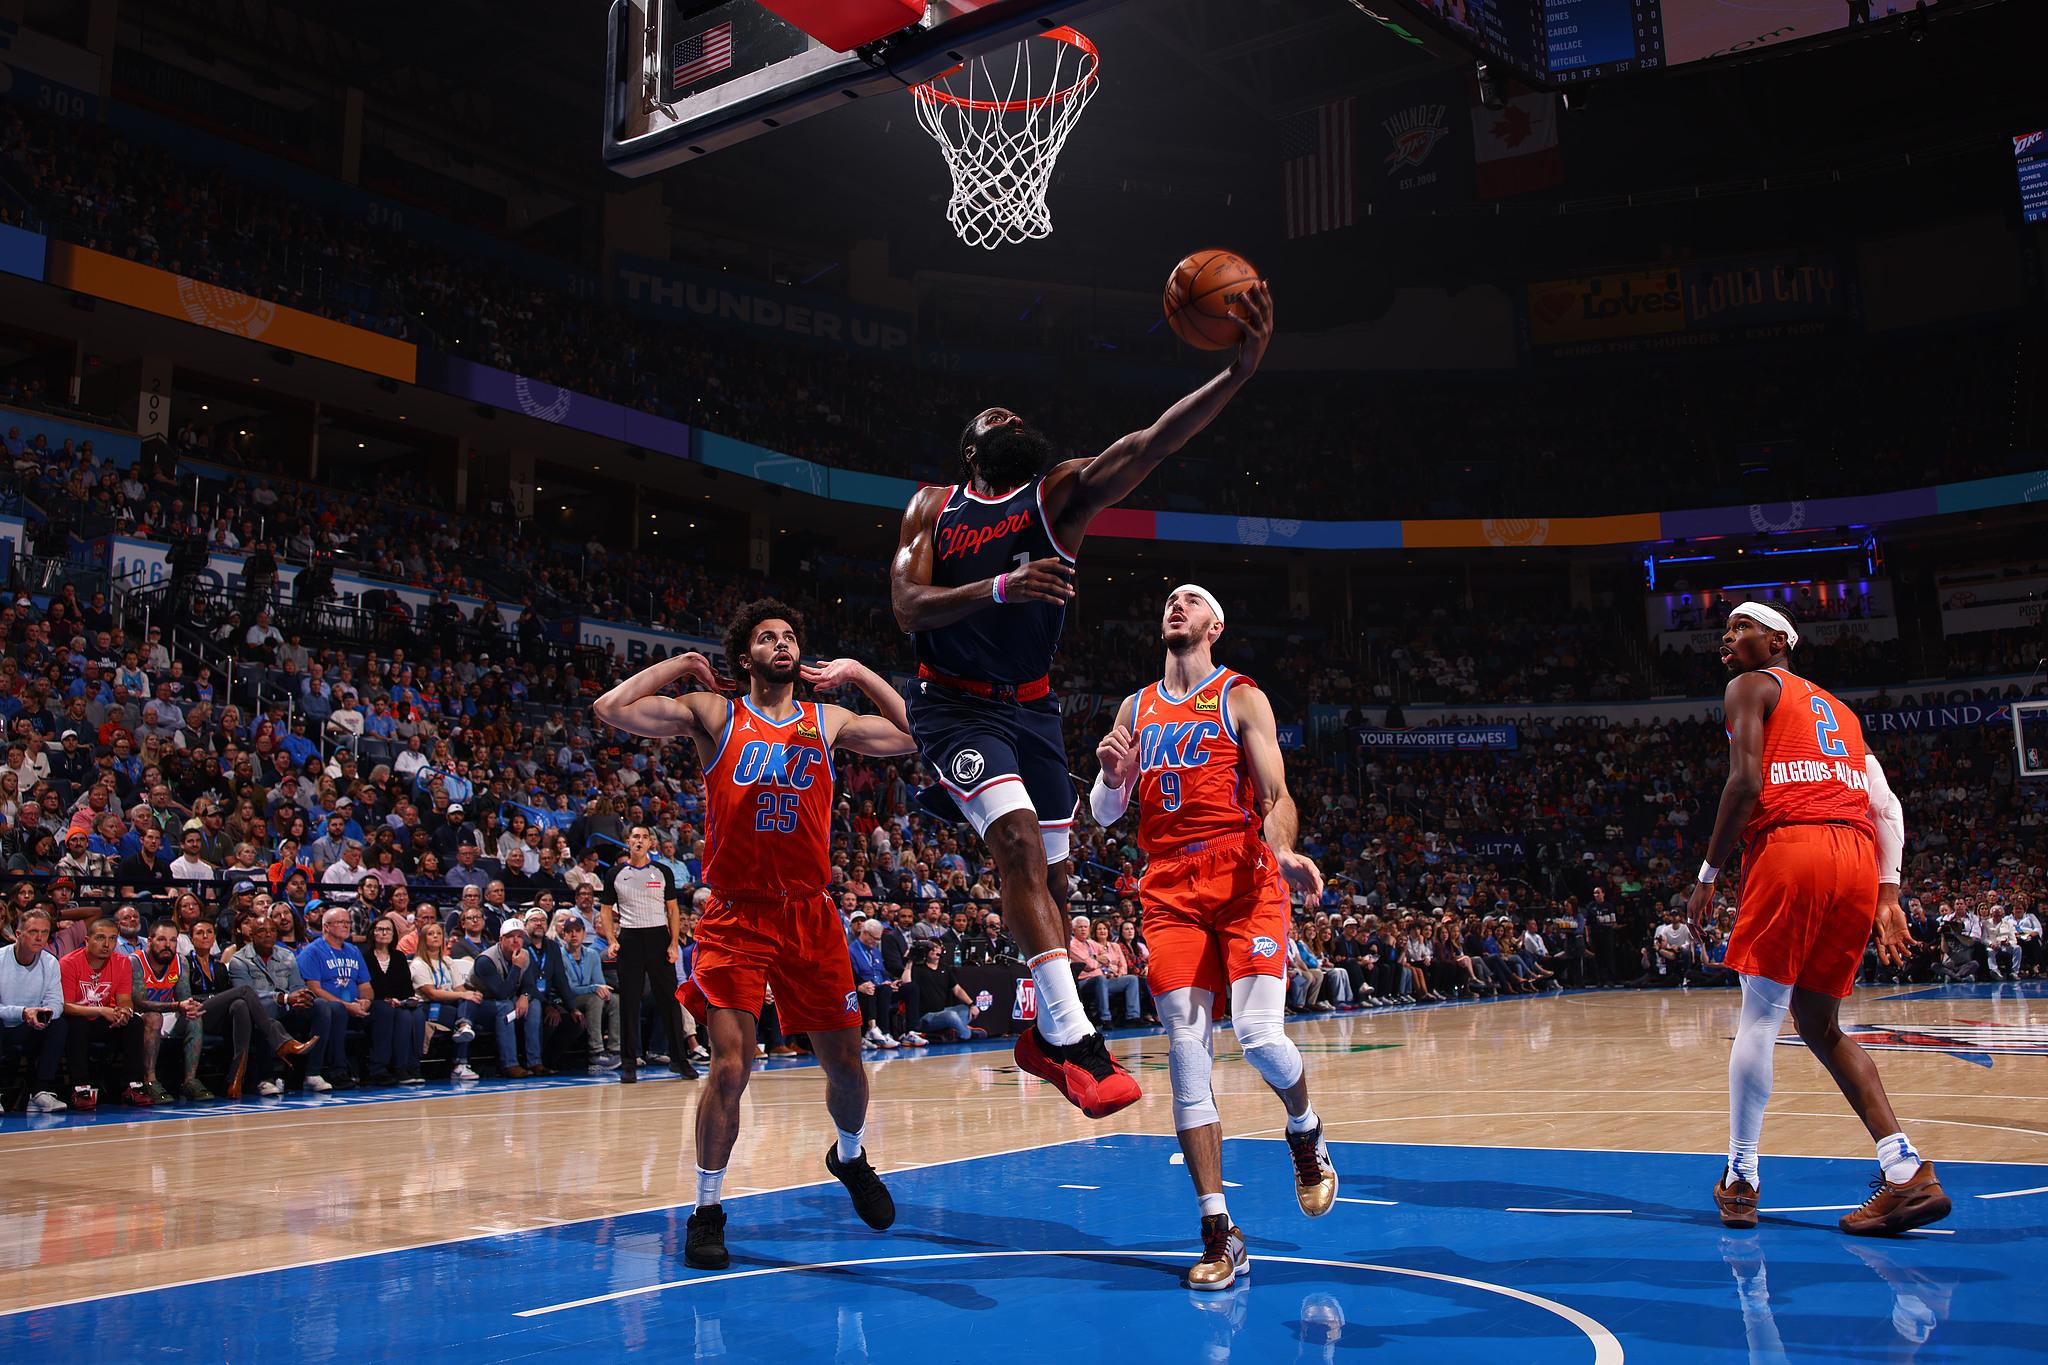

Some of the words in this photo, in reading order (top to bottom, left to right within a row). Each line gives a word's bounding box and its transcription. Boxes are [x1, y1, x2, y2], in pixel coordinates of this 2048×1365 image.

[1546, 12, 1570, 23] JONES
[1547, 26, 1578, 38] CARUSO
[1548, 40, 1583, 53] WALLACE
[1550, 54, 1587, 67] MITCHELL
[1640, 58, 1658, 69] 2:29
[38, 84, 85, 121] 309
[1381, 104, 1446, 138] THUNDER
[2020, 173, 2041, 182] JONES
[620, 267, 843, 342] THUNDER
[850, 317, 909, 353] UP
[148, 377, 162, 426] 209
[938, 508, 1035, 562] Clippers
[117, 555, 164, 588] 106
[1359, 732, 1394, 745] YOUR
[1395, 732, 1455, 746] FAVORITE
[1457, 731, 1507, 745] GAMES!
[1810, 695, 1850, 757] 2
[1139, 721, 1220, 773] OKC
[733, 740, 823, 791] OKC
[1159, 771, 1182, 812] 9
[755, 791, 800, 833] 25
